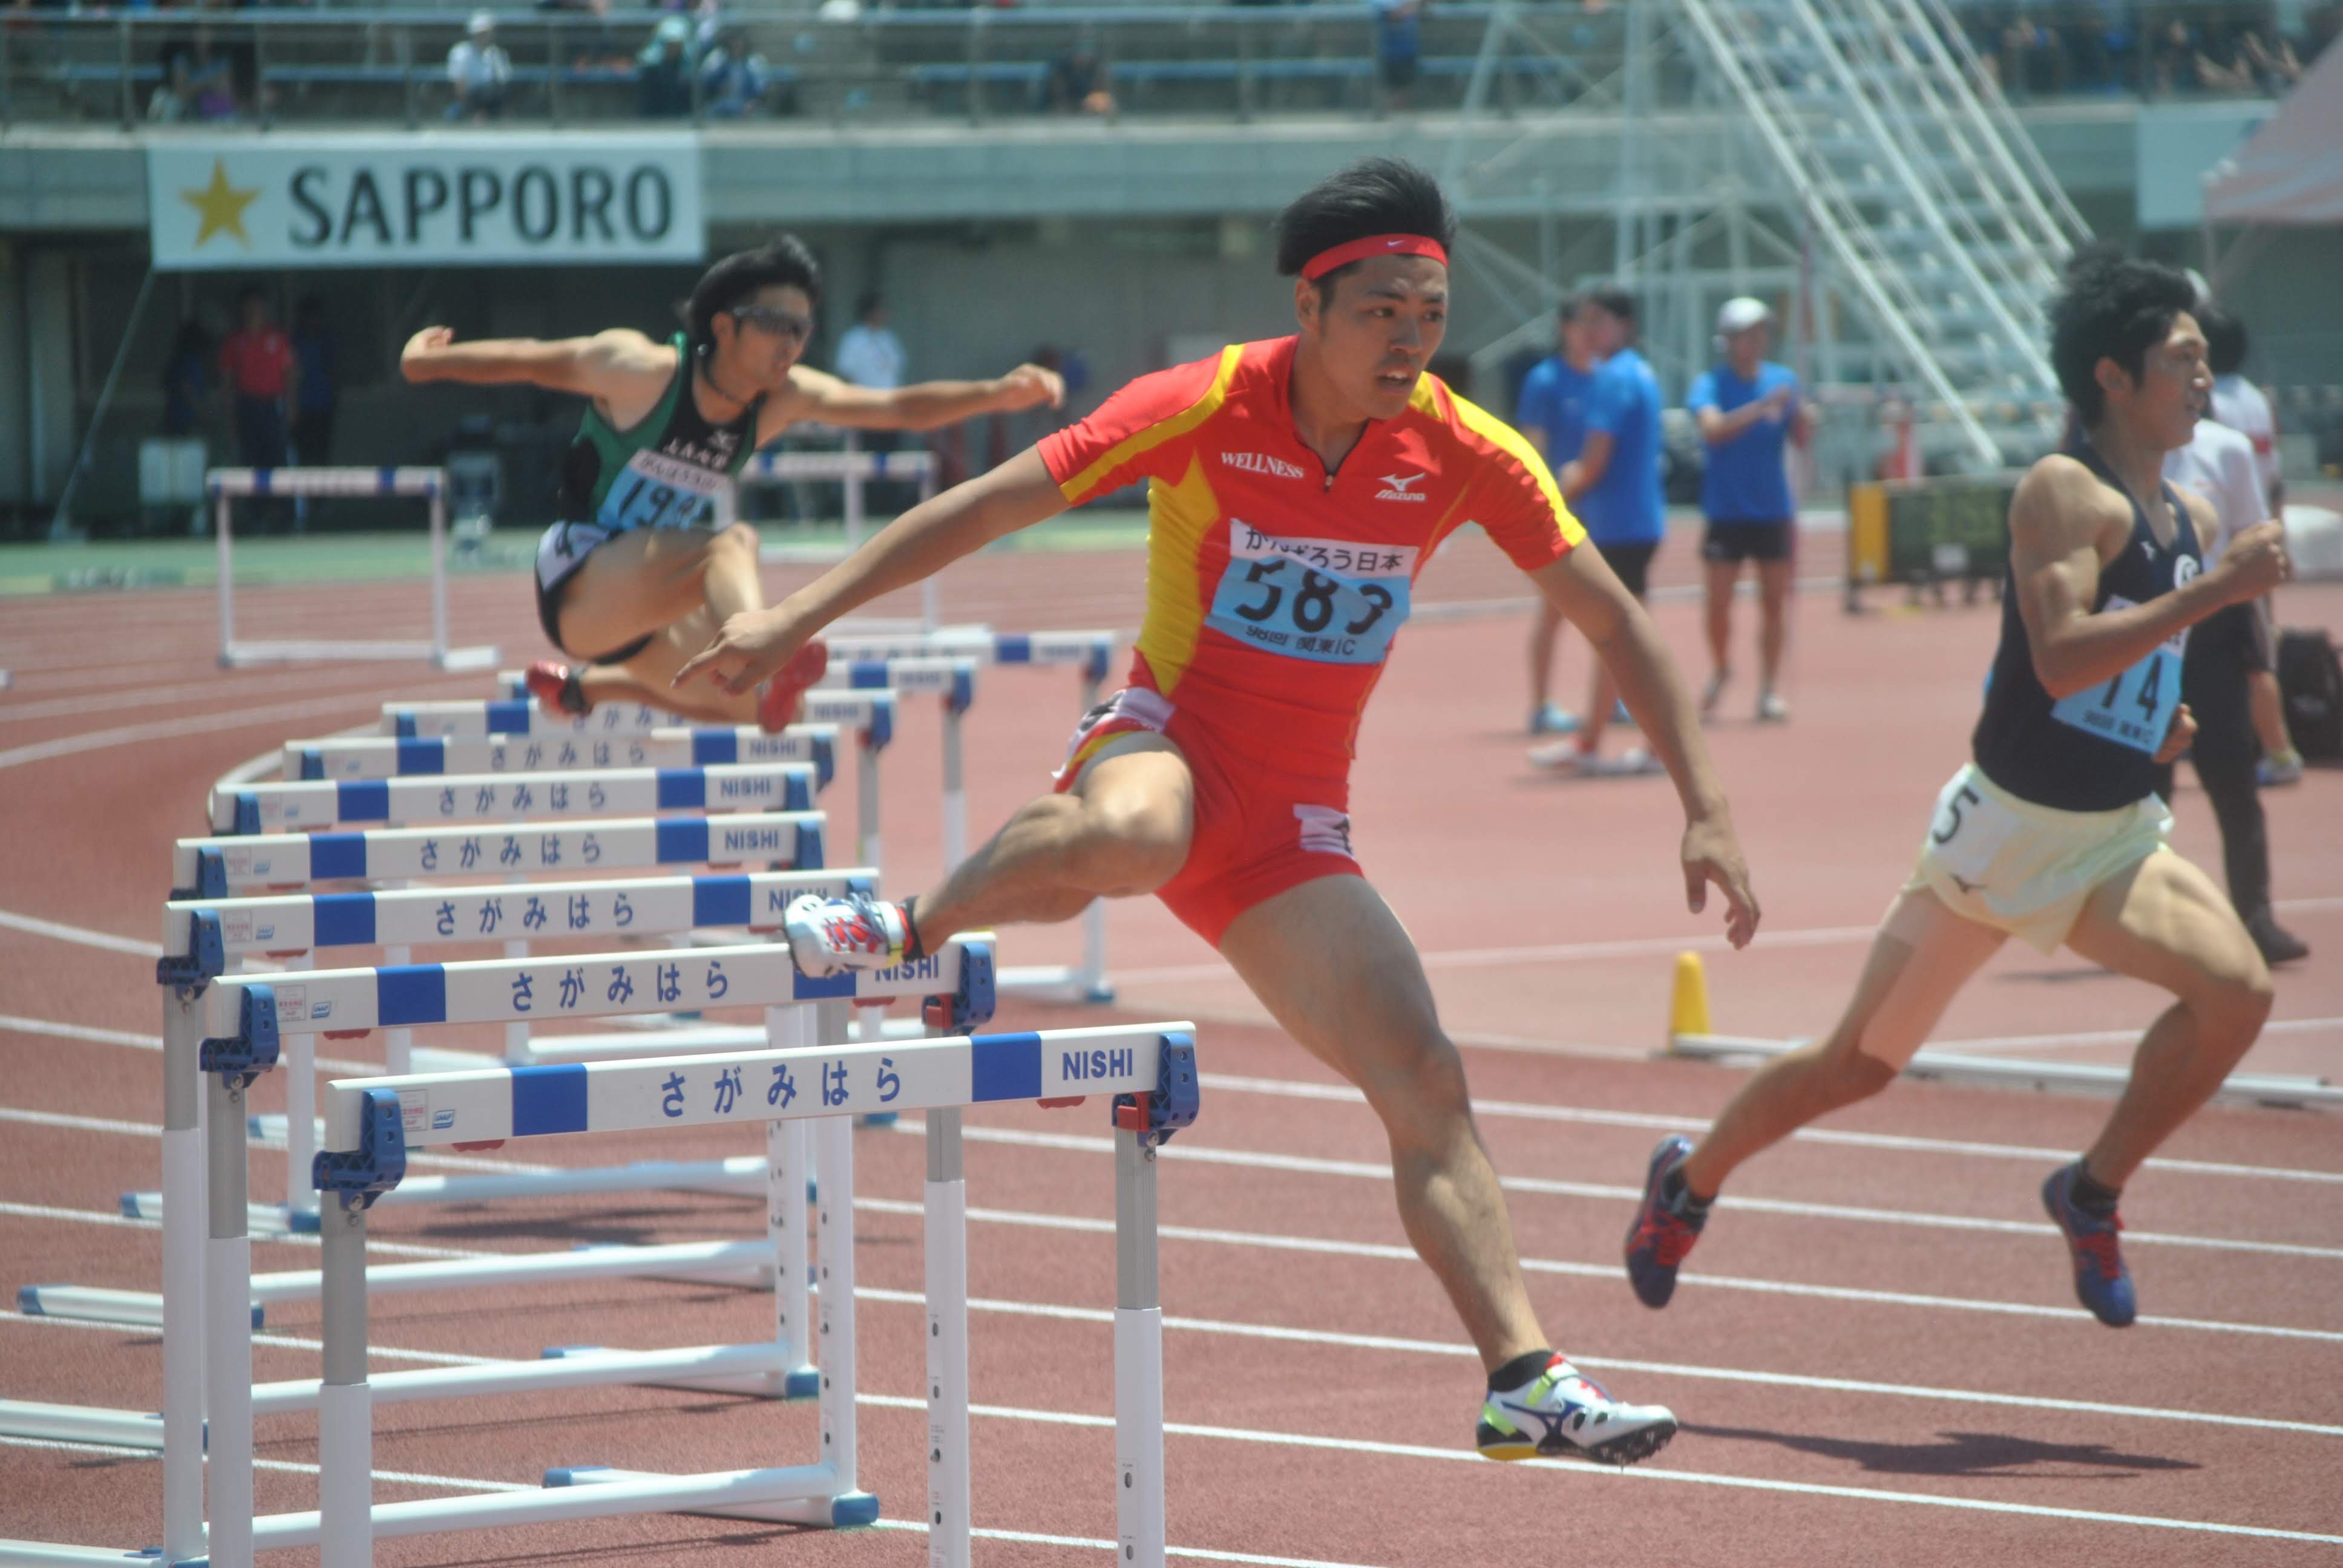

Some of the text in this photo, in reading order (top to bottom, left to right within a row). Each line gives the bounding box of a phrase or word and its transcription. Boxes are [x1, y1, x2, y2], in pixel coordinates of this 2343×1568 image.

[288, 165, 673, 245] SAPPORO
[1221, 452, 1304, 479] WELLNESS
[1233, 560, 1392, 636] 583
[439, 778, 772, 816] さがみはら NISHI
[1932, 787, 1979, 844] 5
[420, 830, 779, 871] さがみはら NISHI
[435, 892, 634, 936] さがみはら
[511, 960, 729, 1013] さがみはら
[661, 1047, 1133, 1119] さがみはら NISHI
